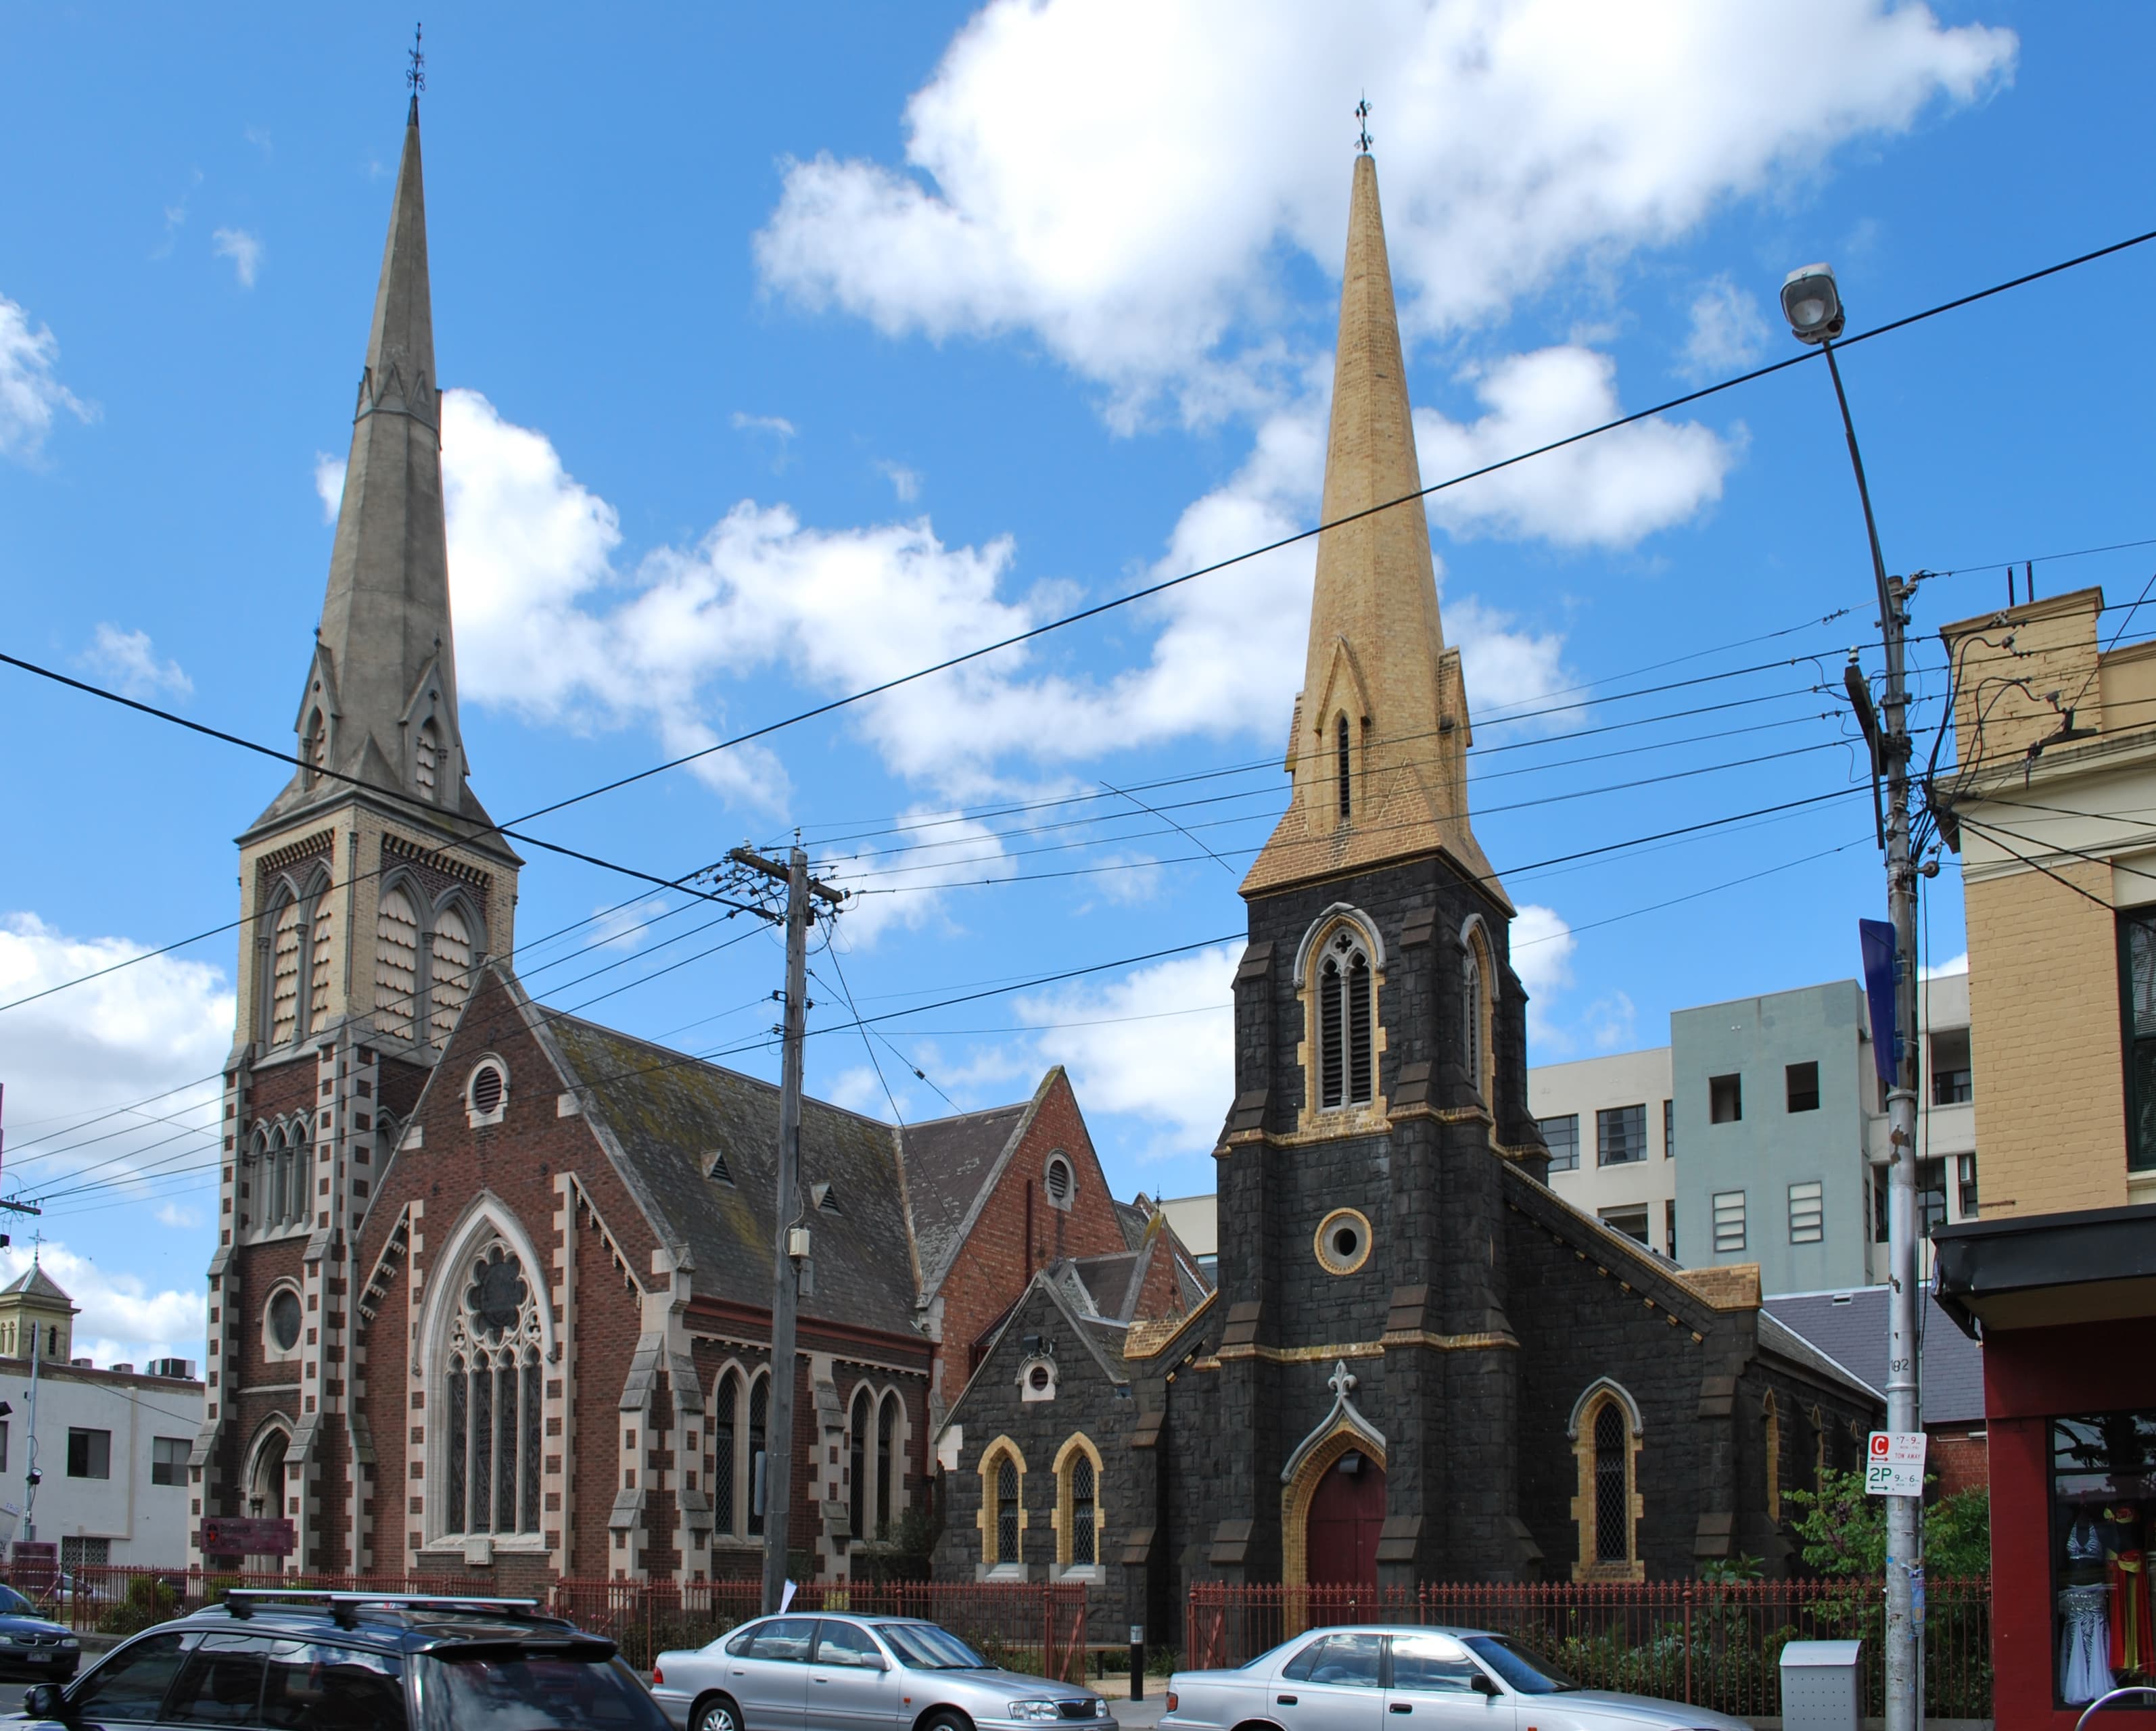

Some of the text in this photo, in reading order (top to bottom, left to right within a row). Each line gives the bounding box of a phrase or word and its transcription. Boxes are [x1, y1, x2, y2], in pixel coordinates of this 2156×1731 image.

[1891, 1358, 1909, 1372] 182
[1875, 1438, 1885, 1453] C
[1869, 1467, 1892, 1481] 2P
